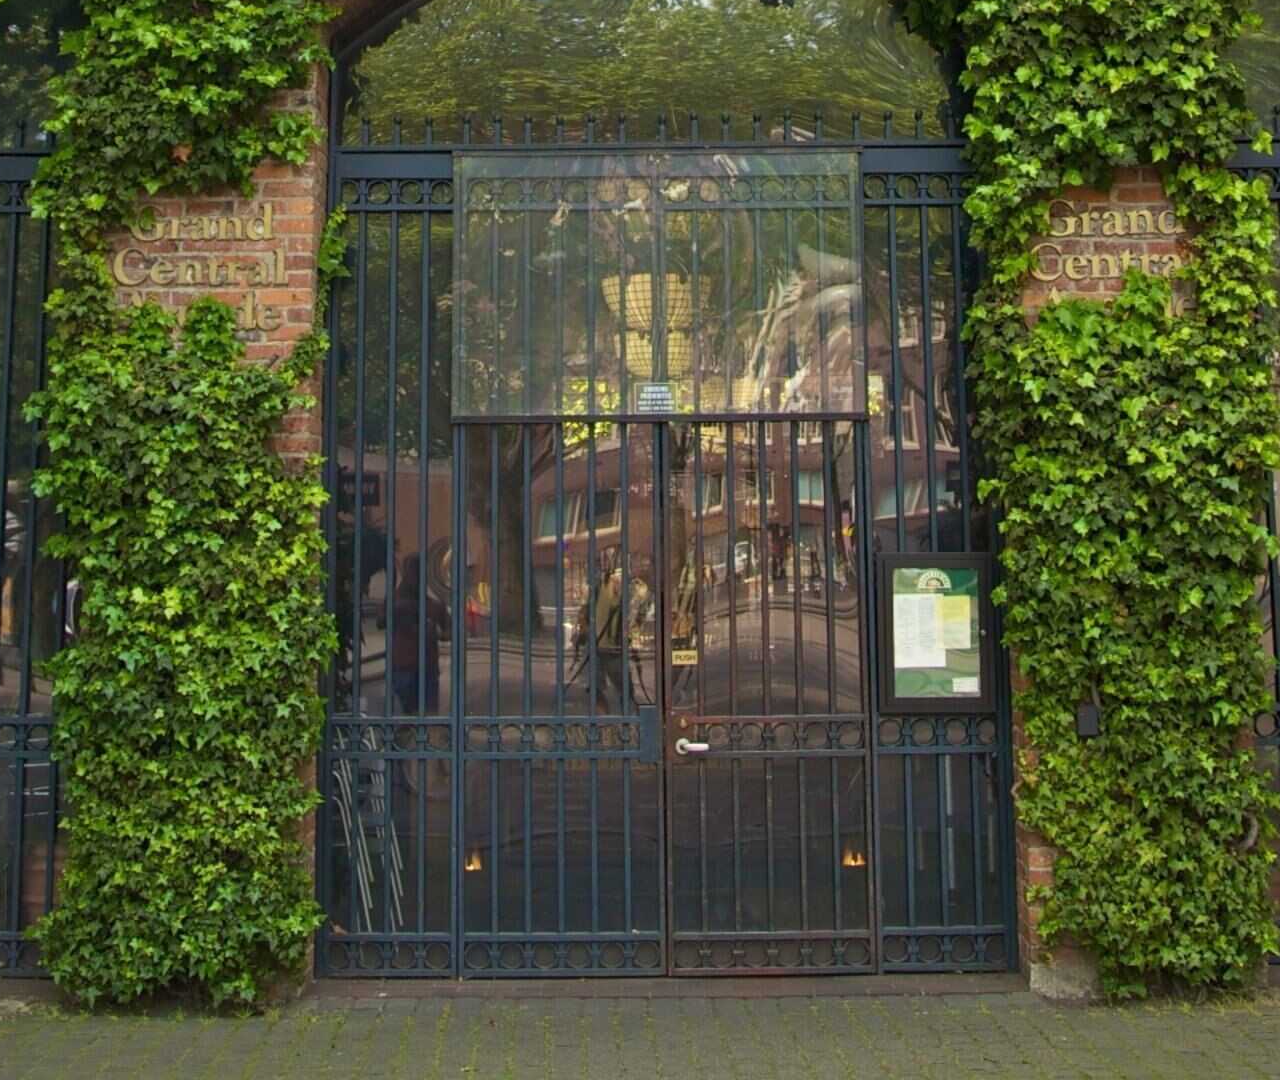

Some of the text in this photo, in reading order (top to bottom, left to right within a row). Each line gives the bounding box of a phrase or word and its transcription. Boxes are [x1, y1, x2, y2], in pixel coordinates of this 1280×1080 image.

[129, 202, 276, 242] Grand
[113, 247, 290, 287] Central
[1031, 243, 1190, 281] Centra
[674, 654, 696, 662] PUSH
